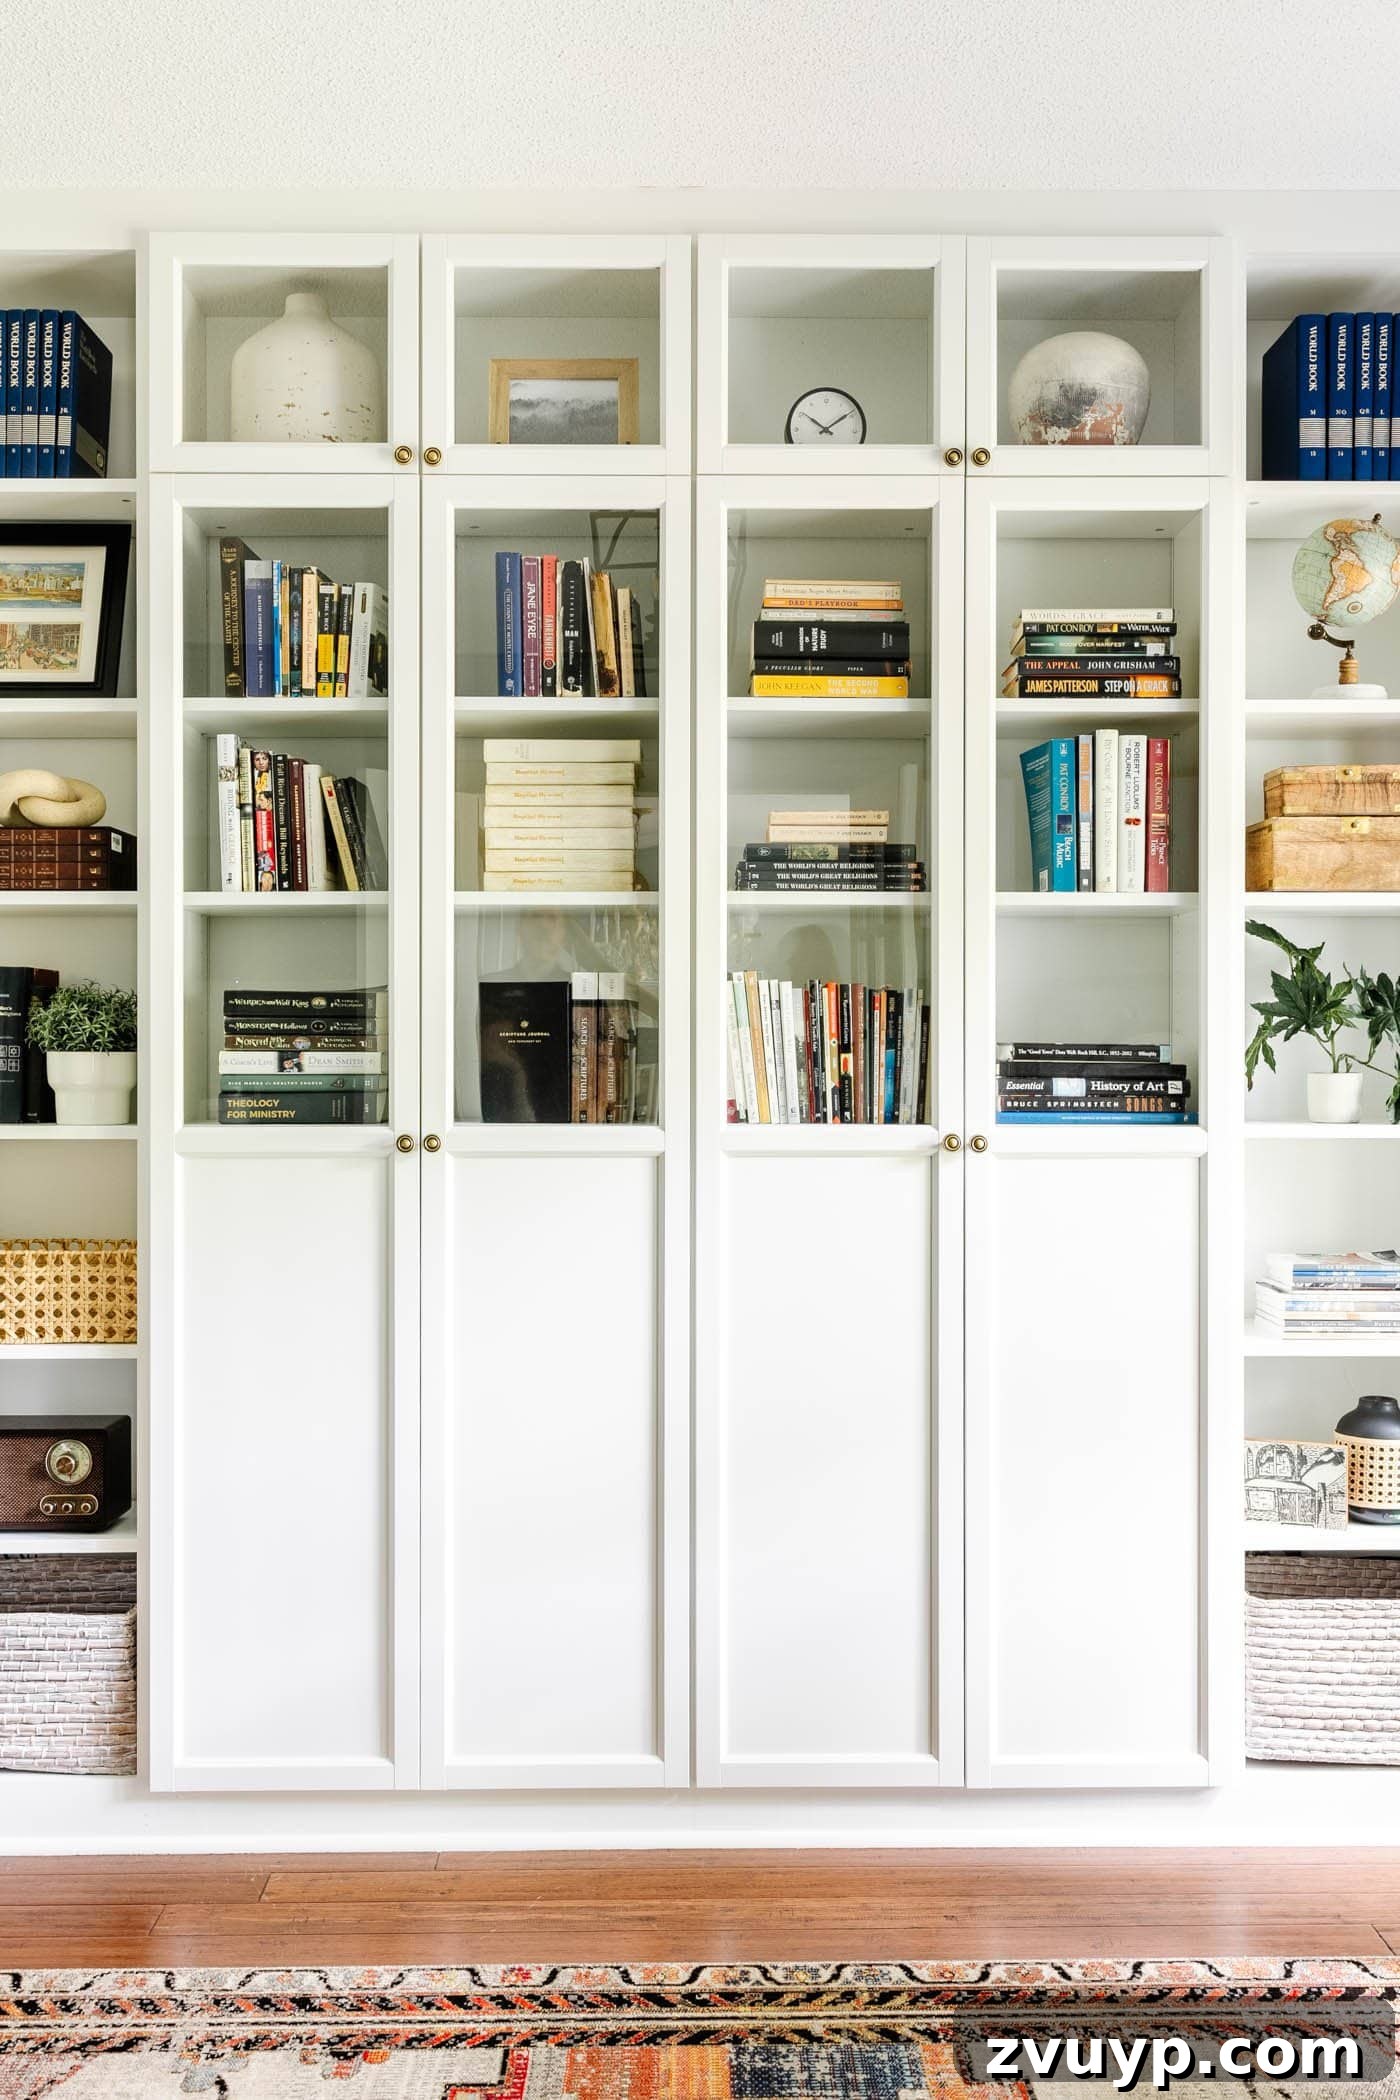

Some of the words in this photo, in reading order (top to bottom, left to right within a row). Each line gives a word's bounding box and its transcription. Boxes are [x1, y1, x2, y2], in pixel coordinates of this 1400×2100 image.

[11, 321, 20, 358] WORLD
[27, 321, 36, 358] WORLD
[44, 321, 53, 358] WORLD
[63, 322, 72, 359] WORLD
[1309, 326, 1318, 362] WORLD
[1337, 325, 1347, 361] WORLD
[1361, 324, 1371, 361] WORLD
[1379, 324, 1389, 361] WORLD
[10, 360, 19, 388] BOOK
[26, 360, 36, 388] BOOK
[44, 360, 53, 388] BOOK
[61, 360, 71, 389] BOOK
[1309, 364, 1318, 392] BOOK
[1337, 363, 1346, 391] BOOK
[1361, 362, 1370, 390] BOOK
[1378, 363, 1388, 391] BOOK
[527, 582, 536, 610] JANE
[815, 600, 859, 608] PLAYBOOK
[528, 612, 537, 639] EYRE
[544, 615, 554, 657] FAHRENHEIT
[565, 630, 579, 638] MAN
[1046, 624, 1059, 633] PAT
[1060, 624, 1095, 633] CONROY
[1152, 625, 1171, 633] WIDE
[1024, 662, 1044, 670] THE
[1046, 662, 1081, 670] APPEAL
[1087, 661, 1112, 670] JOHN
[1114, 661, 1156, 670] GRISHAM
[759, 681, 782, 690] JOHN
[784, 681, 822, 691] KEEGAN
[1025, 680, 1053, 693] JAMES
[1054, 680, 1099, 693] PATTERSON
[1105, 680, 1123, 693] STEP
[1124, 681, 1135, 692] ON
[1142, 681, 1169, 692] CRACK
[1060, 763, 1068, 777] PAT
[1133, 742, 1141, 775] ROBERT
[1155, 762, 1163, 775] PAT
[1060, 778, 1069, 812] CONROY
[1154, 777, 1163, 811] CONROY
[280, 827, 288, 840] Bill
[280, 842, 288, 874] Reynolds
[1056, 842, 1065, 868] MUSIC
[1065, 837, 1073, 861] BEACH
[308, 1056, 331, 1065] DEAN
[335, 1056, 364, 1065] SMITH
[580, 1057, 588, 1101] SCRIPTURES
[1006, 1081, 1044, 1091] Essential
[1091, 1081, 1130, 1092] History
[1133, 1081, 1144, 1091] of
[1146, 1081, 1164, 1091] Art
[227, 1100, 280, 1108] THEOLOGY
[227, 1110, 247, 1119] FOR
[249, 1110, 296, 1119] MINISTRY
[1126, 1098, 1163, 1112] SONGS
